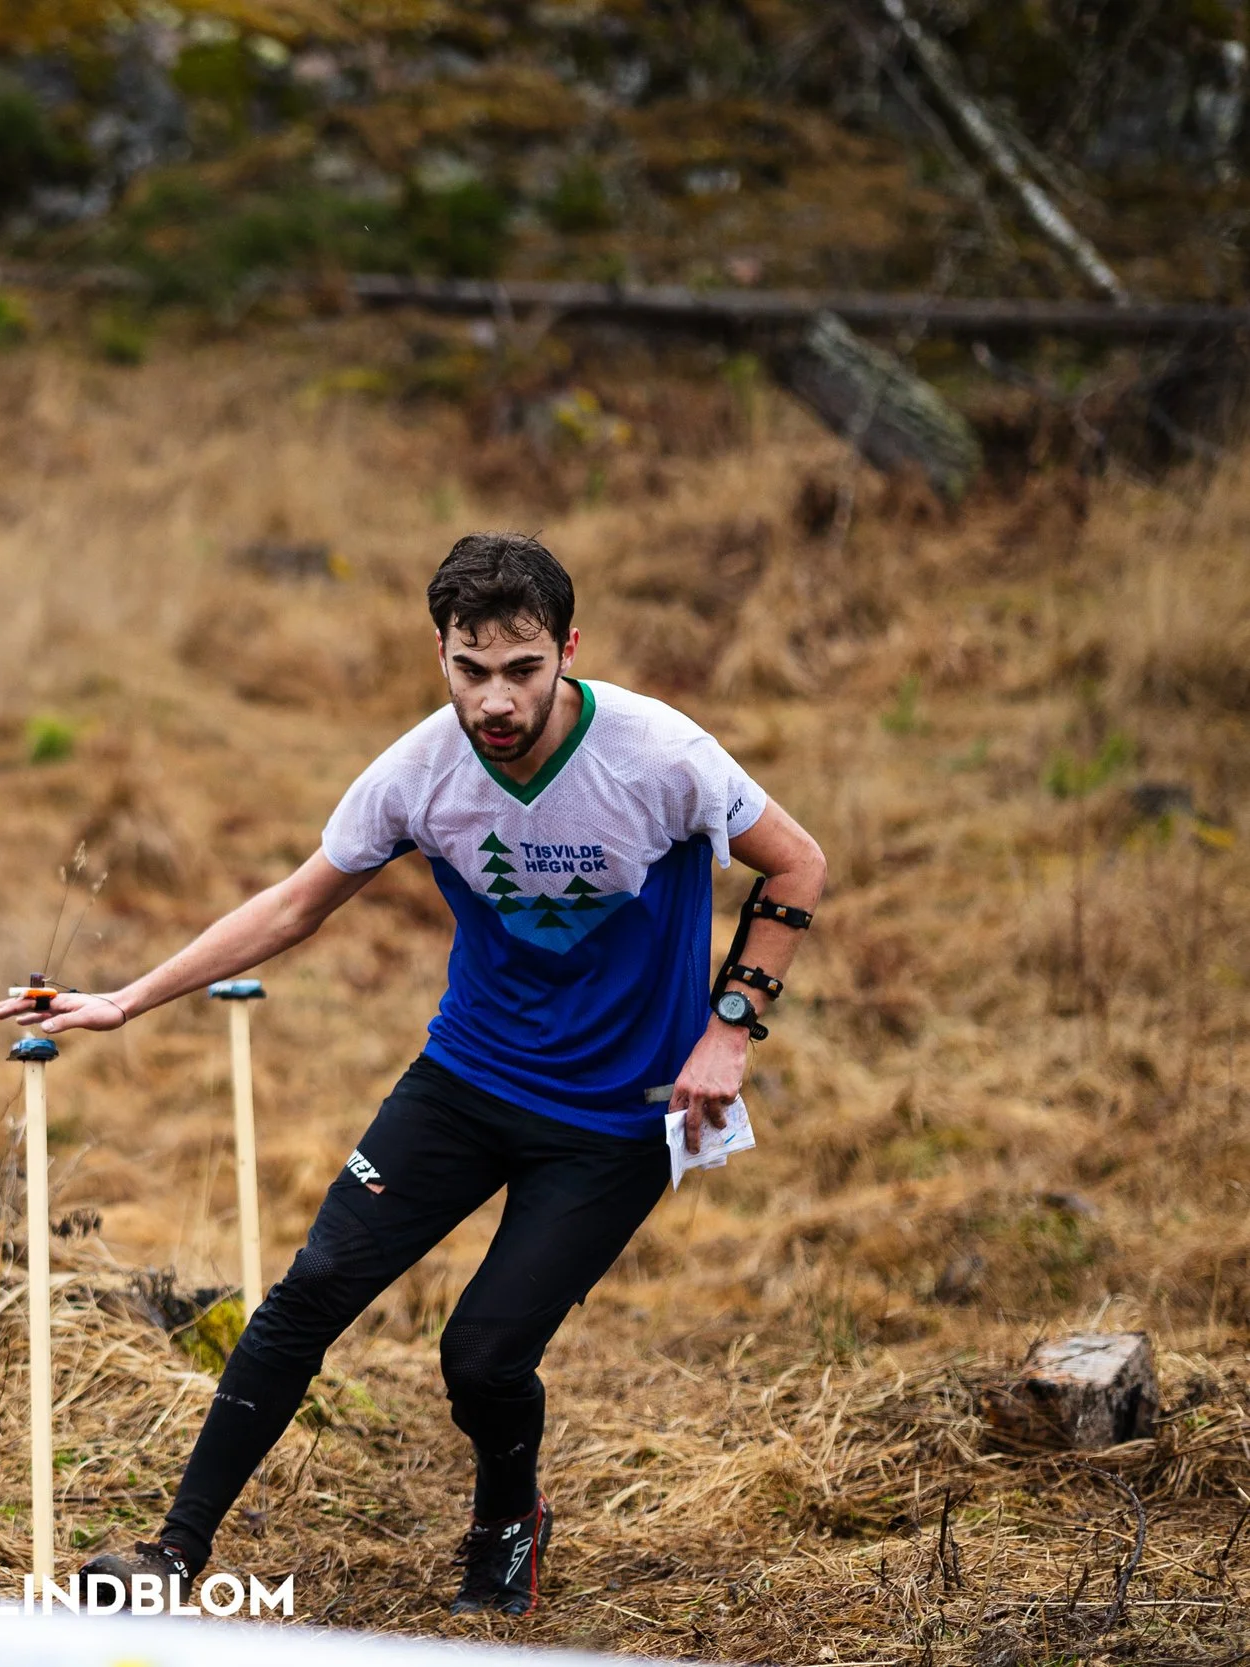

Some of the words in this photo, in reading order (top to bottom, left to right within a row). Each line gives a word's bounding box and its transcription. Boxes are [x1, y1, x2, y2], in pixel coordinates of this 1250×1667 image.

[520, 842, 604, 859] TISVILDE
[525, 859, 575, 873] HEGN
[580, 858, 609, 873] OK
